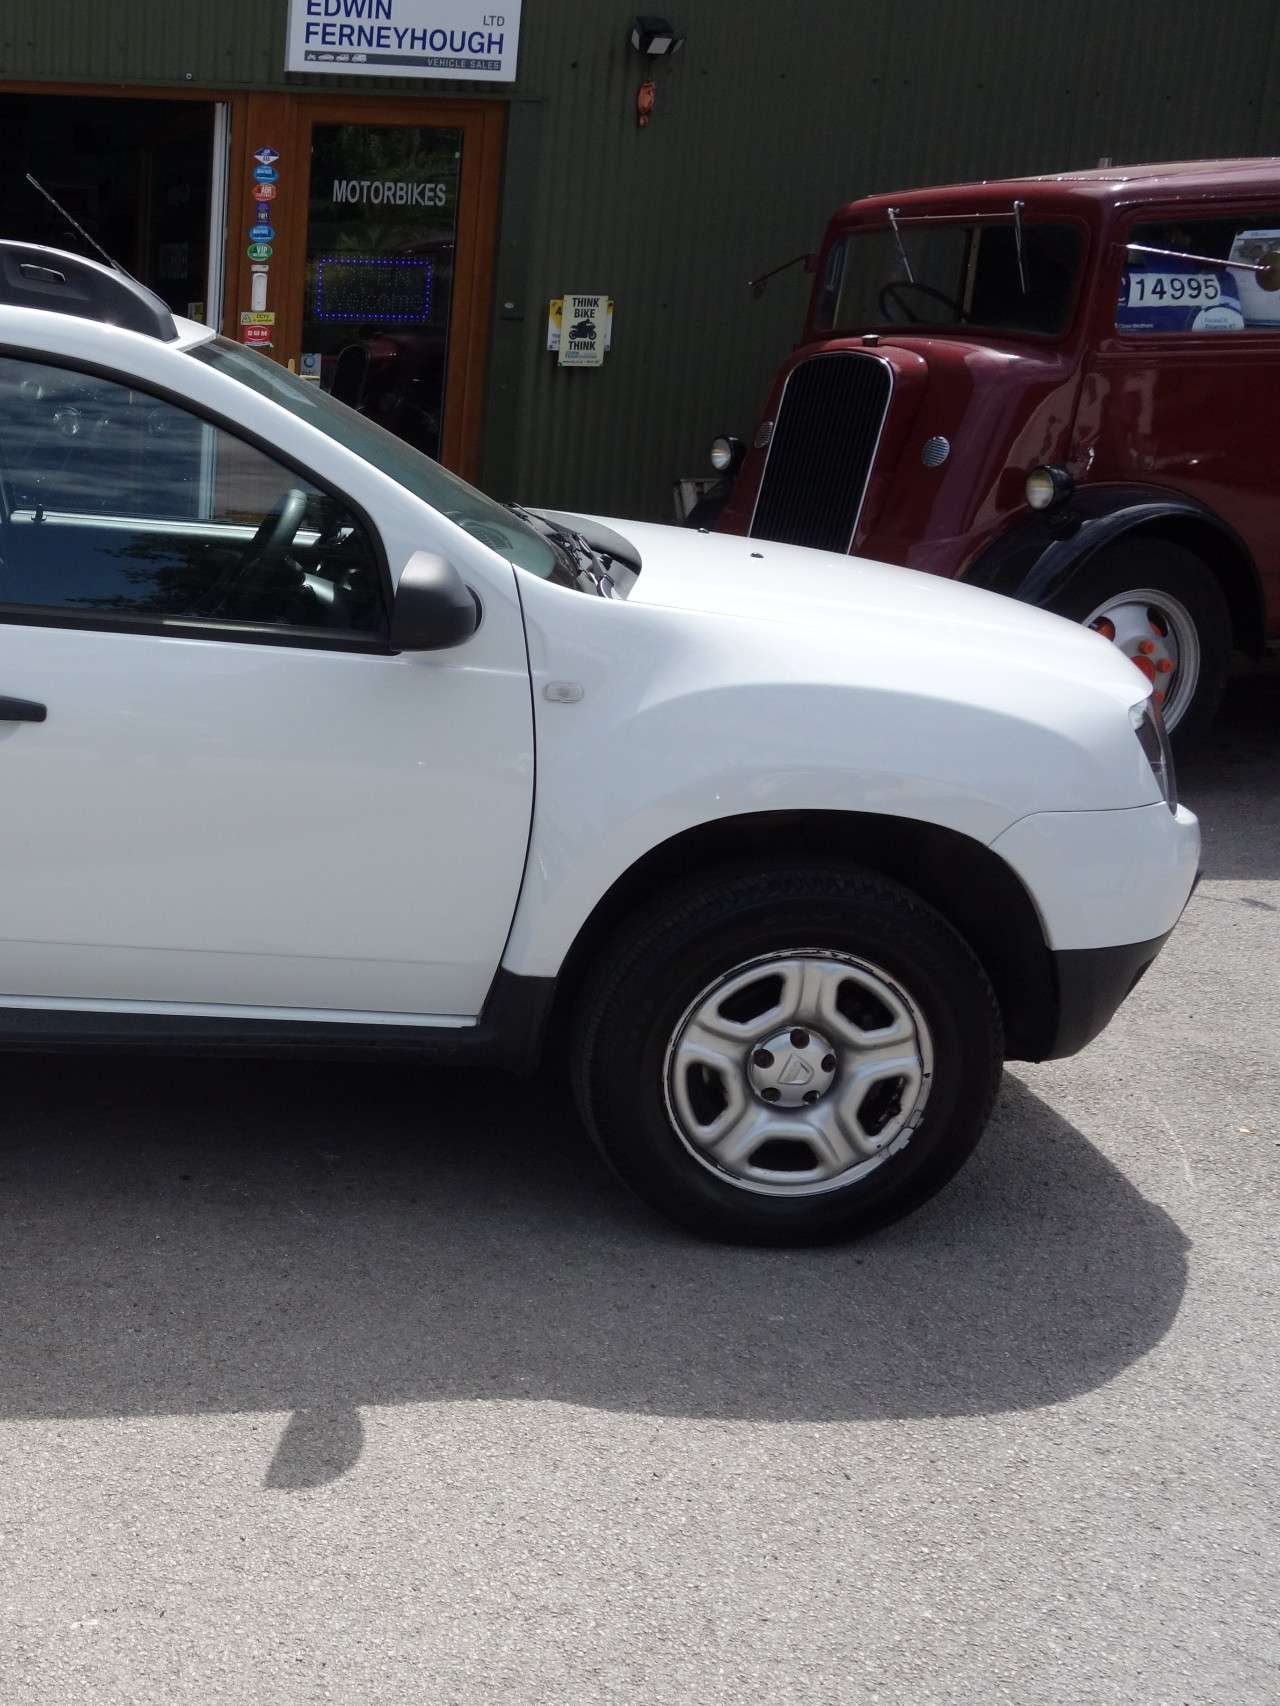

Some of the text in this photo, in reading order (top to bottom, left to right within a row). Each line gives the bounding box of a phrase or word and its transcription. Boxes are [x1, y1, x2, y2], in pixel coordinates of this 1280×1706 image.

[306, 0, 392, 20] EDWIN
[482, 15, 505, 27] LTD
[304, 22, 505, 55] FERNEYHOUGH
[426, 58, 501, 71] VEHICLE SALES
[332, 179, 447, 206] MOTORBIKES
[1135, 278, 1219, 301] 14995
[572, 297, 600, 308] THINK
[574, 308, 596, 319] BIKE
[568, 340, 596, 351] THINK
